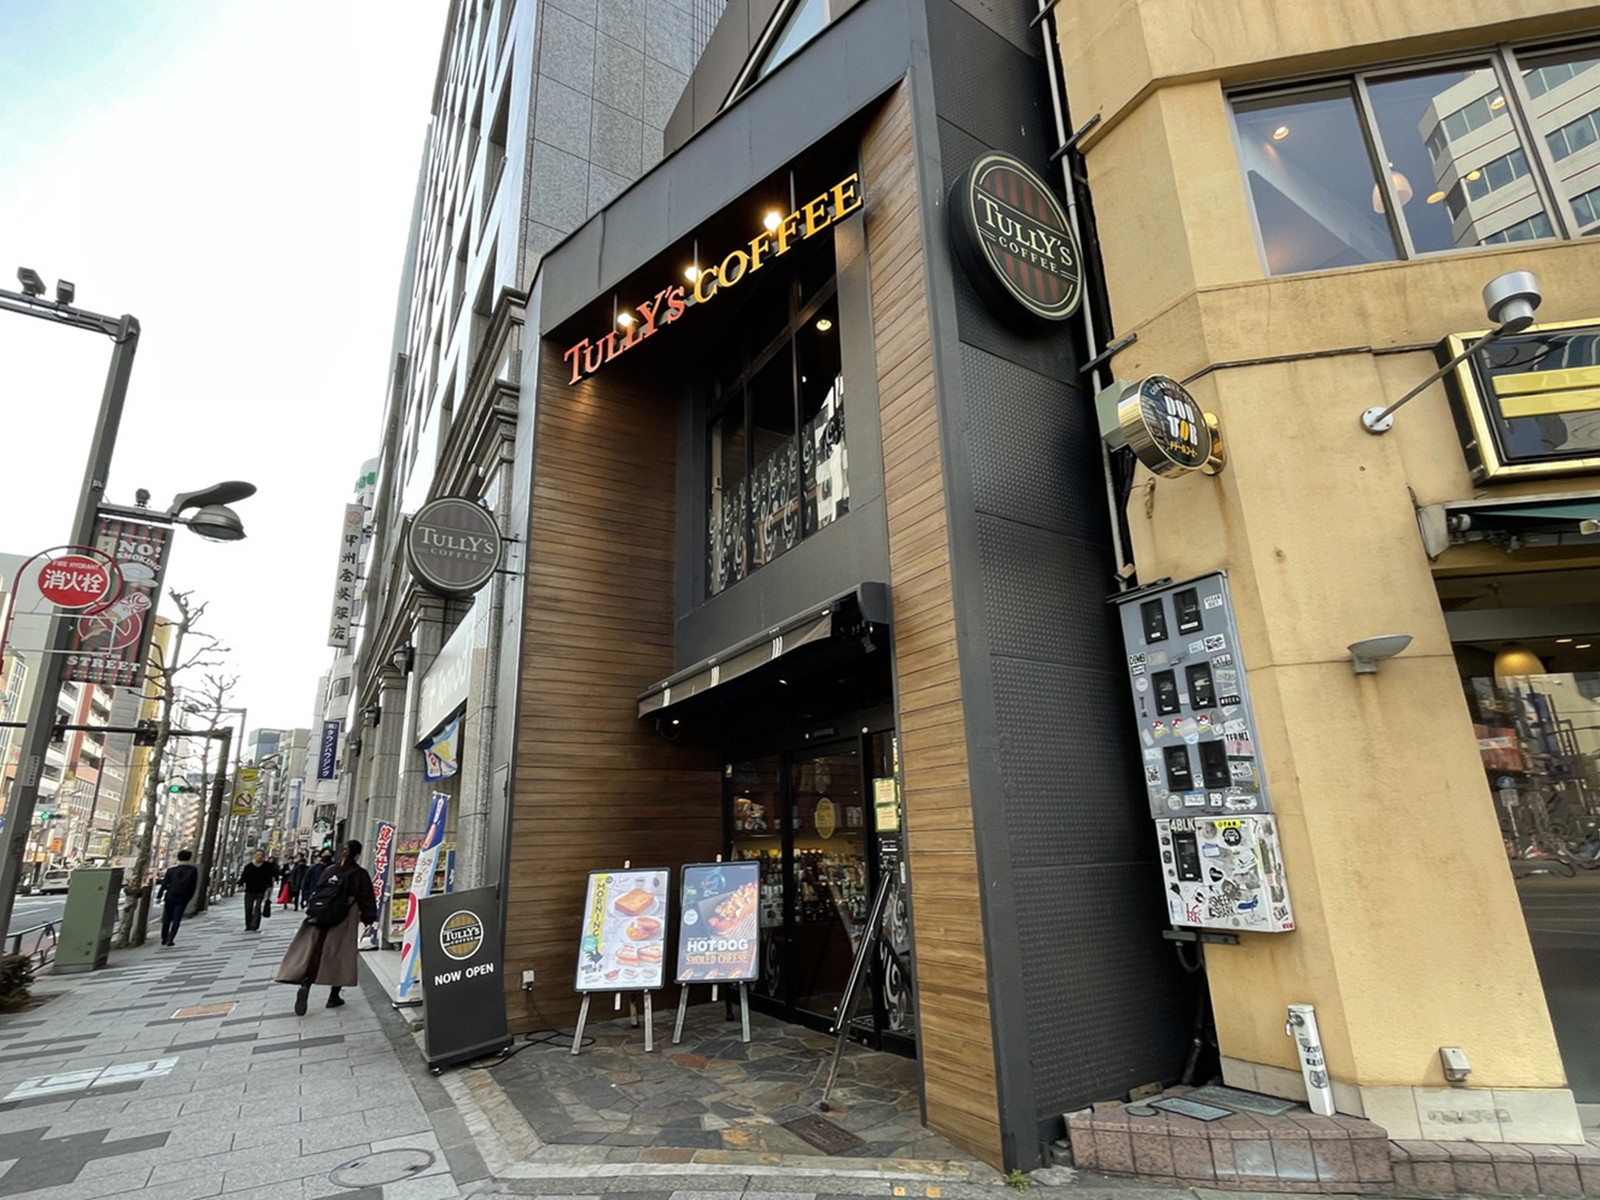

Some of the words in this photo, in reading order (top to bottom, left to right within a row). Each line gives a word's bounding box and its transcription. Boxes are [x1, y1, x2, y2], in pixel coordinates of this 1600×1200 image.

[978, 193, 1073, 267] TULLY'S
[998, 236, 1059, 273] COFFEE
[564, 285, 685, 385] TULLY'S
[694, 173, 862, 303] COFFEE
[418, 526, 494, 555] TULLY'S
[116, 552, 162, 571] SMOKING
[430, 547, 479, 561] COFFEE
[69, 562, 100, 570] HYDRANT
[43, 568, 104, 594] 消火栓
[66, 655, 141, 672] STREET
[443, 926, 480, 941] TULLY'S
[717, 953, 749, 964] CHEESE
[434, 970, 462, 986] NOW
[465, 963, 494, 978] OPEN
